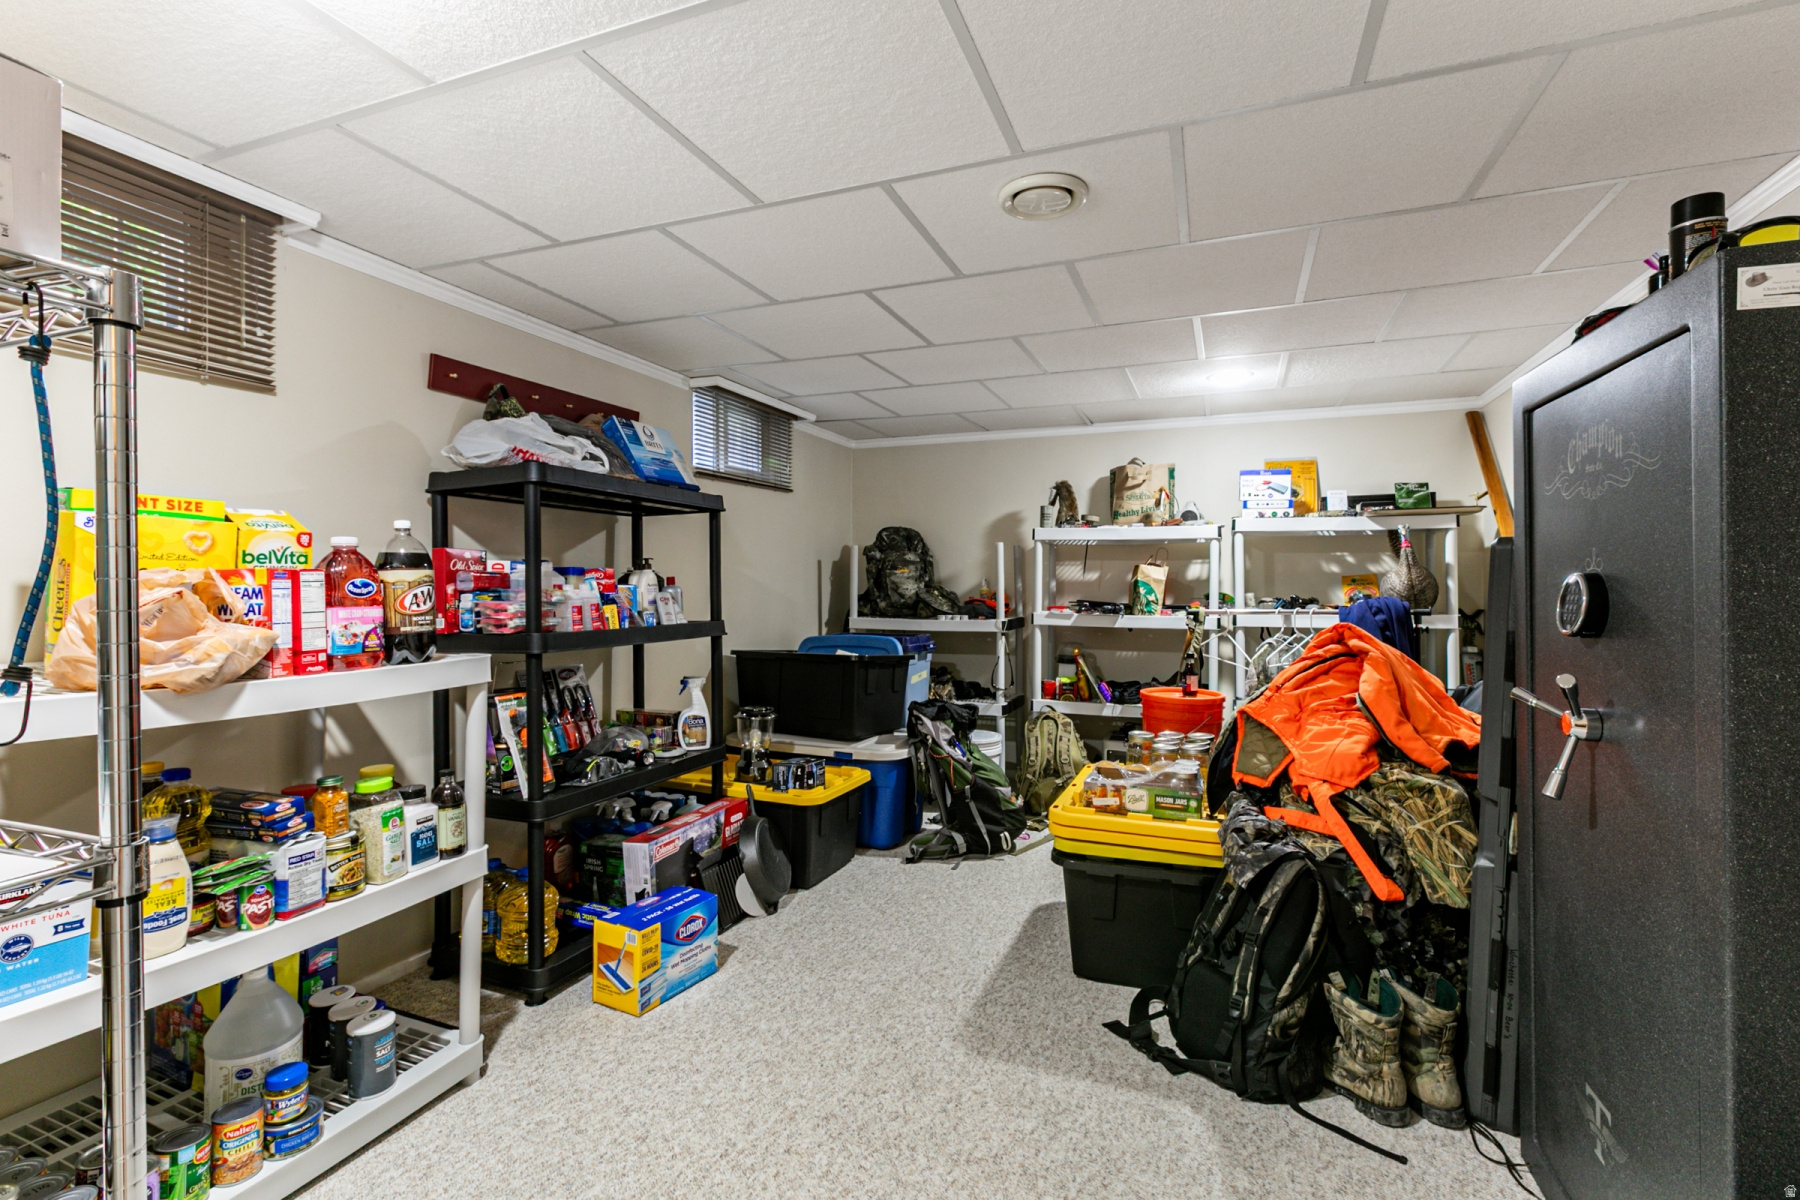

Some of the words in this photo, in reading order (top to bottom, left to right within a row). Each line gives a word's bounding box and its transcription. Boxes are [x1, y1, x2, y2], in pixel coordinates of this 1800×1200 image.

[644, 439, 664, 451] BRITA
[166, 499, 205, 514] SIZE
[137, 552, 164, 562] imited
[166, 553, 199, 562] Edition
[241, 545, 309, 566] belVita
[450, 558, 466, 571] Old
[466, 559, 486, 572] Spice
[407, 587, 434, 612] A&W
[687, 717, 705, 727] Bona
[1155, 795, 1174, 804] MASON
[1174, 797, 1188, 806] JARS
[416, 836, 436, 849] SALT
[654, 837, 681, 858] Coleman
[289, 856, 302, 865] RED
[302, 851, 316, 861] STAR
[329, 858, 349, 871] BETTER
[583, 863, 604, 873] SPRING
[154, 897, 177, 909] REAL
[250, 895, 271, 903] TOMATO
[168, 911, 186, 922] Best
[565, 908, 581, 919] Wrap
[647, 910, 662, 920] PACK
[0, 918, 36, 933] WHITE
[42, 909, 71, 922] TUNA
[142, 917, 168, 930] Foods
[679, 918, 704, 939] CLOROX
[8, 936, 25, 944] WILD
[679, 942, 704, 960] Disinfecting
[6, 957, 40, 972] WATER
[375, 1045, 392, 1058] SALT
[278, 1093, 305, 1110] Wyler's
[226, 1122, 257, 1139] Nalley
[222, 1132, 258, 1149] ORIGINAL
[280, 1139, 301, 1149] CHICKEN
[227, 1141, 256, 1156] CHILI
